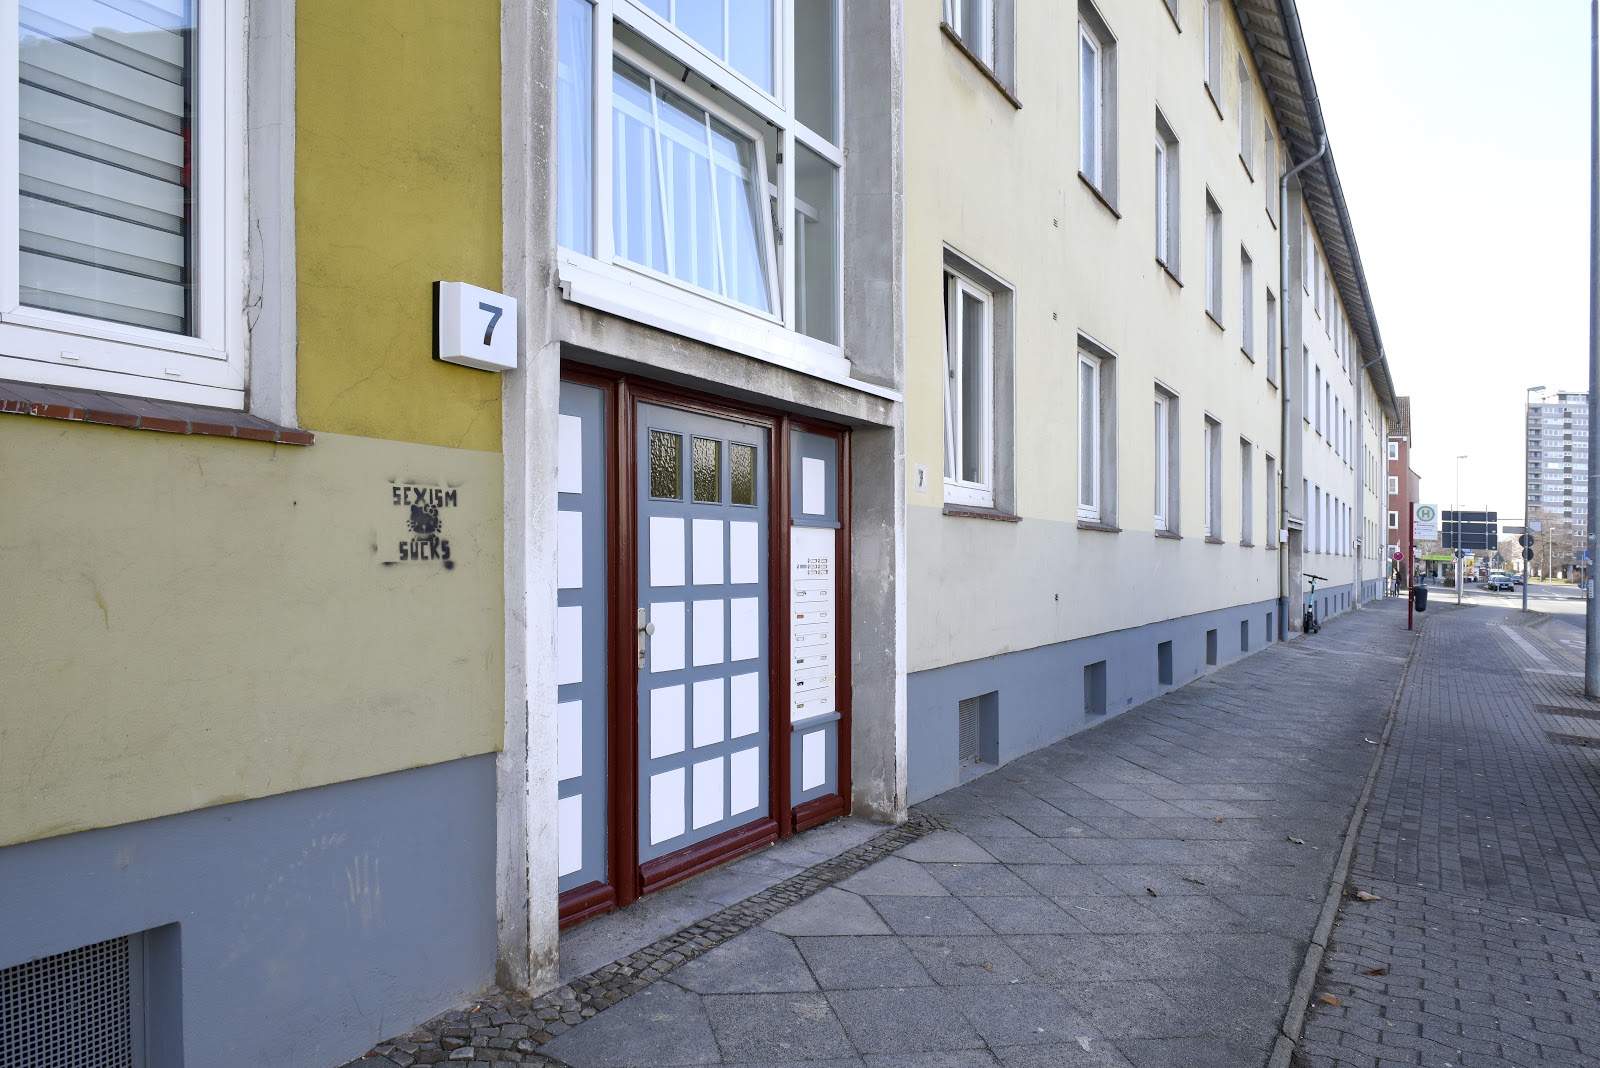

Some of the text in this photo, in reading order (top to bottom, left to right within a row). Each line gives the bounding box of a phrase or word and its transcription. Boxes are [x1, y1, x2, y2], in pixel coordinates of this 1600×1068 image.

[479, 301, 503, 346] 7
[392, 486, 457, 508] SEXISM
[1421, 510, 1430, 518] H
[399, 540, 451, 561] SUCKS
